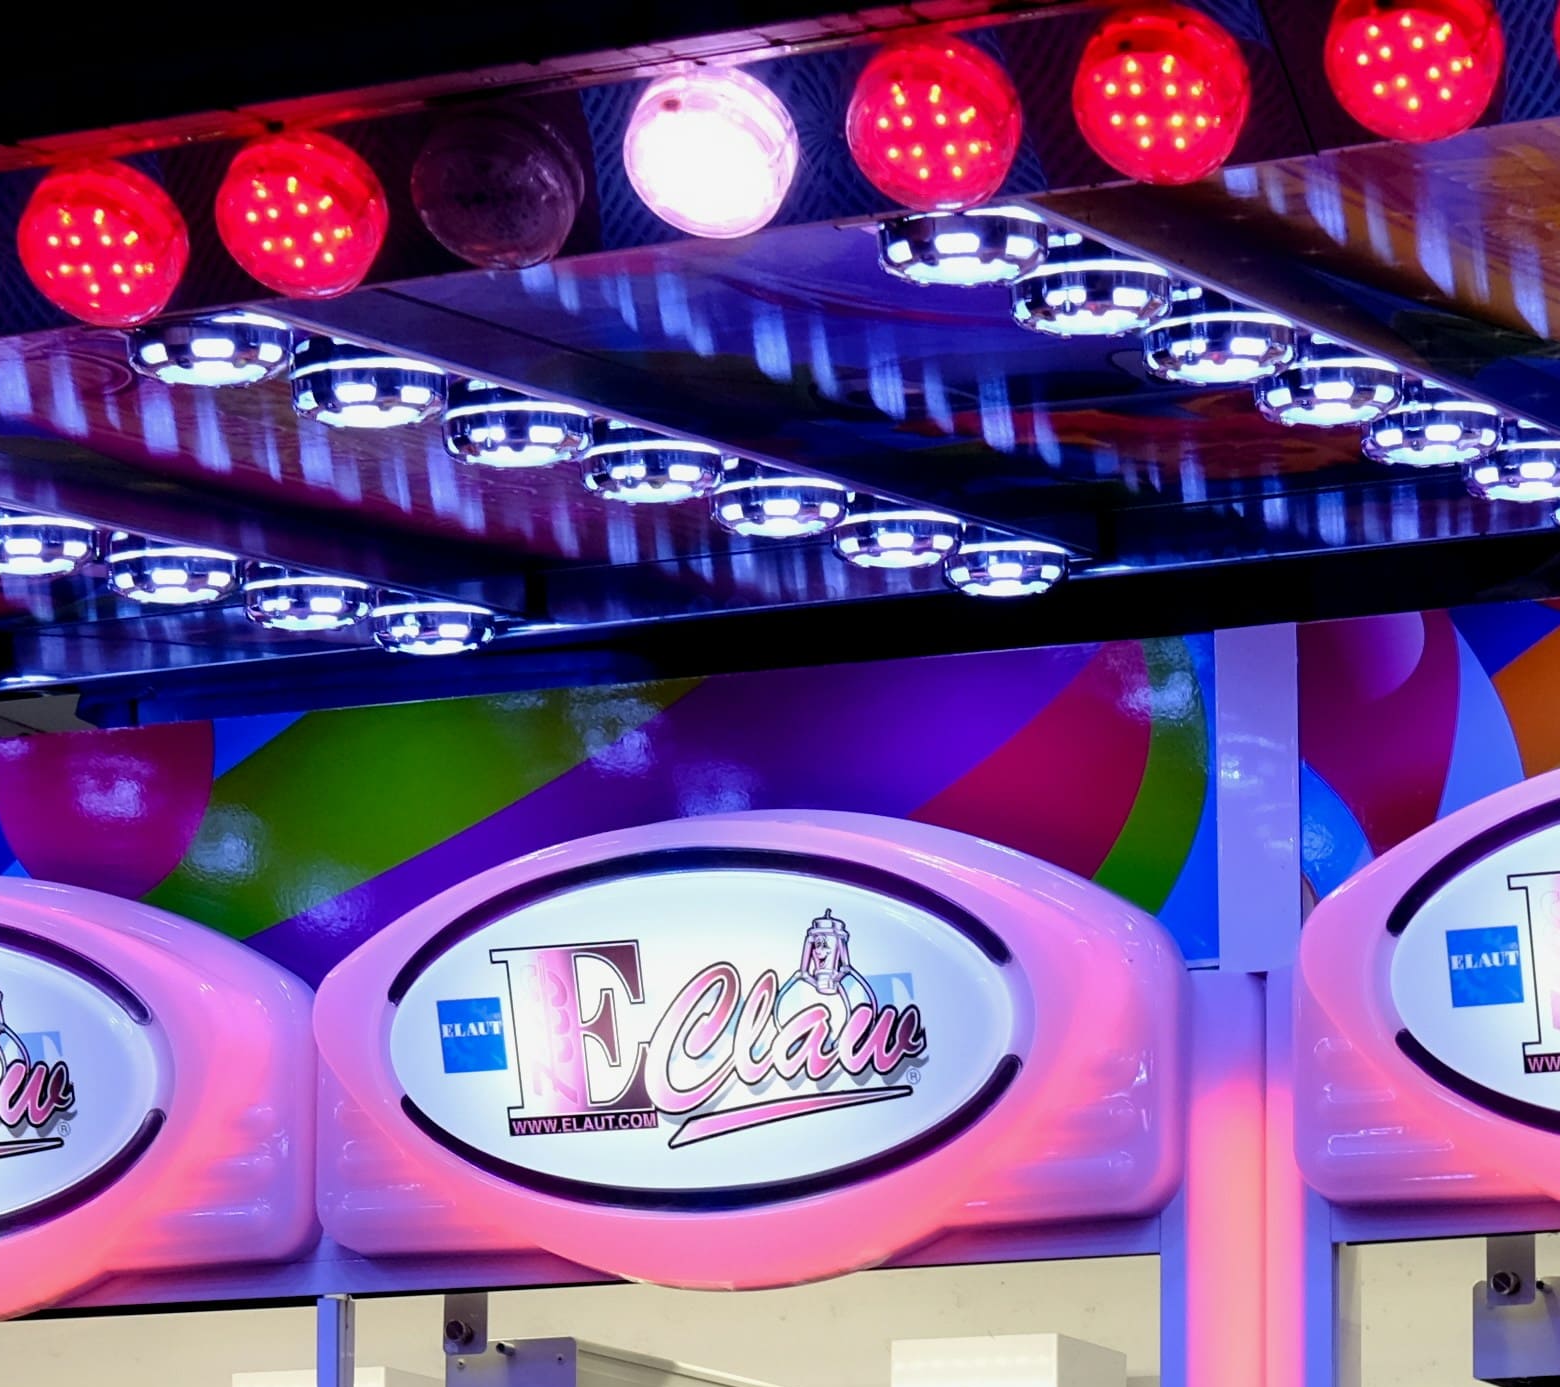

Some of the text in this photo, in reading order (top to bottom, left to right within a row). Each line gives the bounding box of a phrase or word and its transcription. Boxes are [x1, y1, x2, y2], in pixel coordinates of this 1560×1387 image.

[1451, 950, 1519, 970] ELAUT
[442, 1020, 501, 1038] ELAUT
[511, 1112, 658, 1135] WWW.ELAUT.COM
